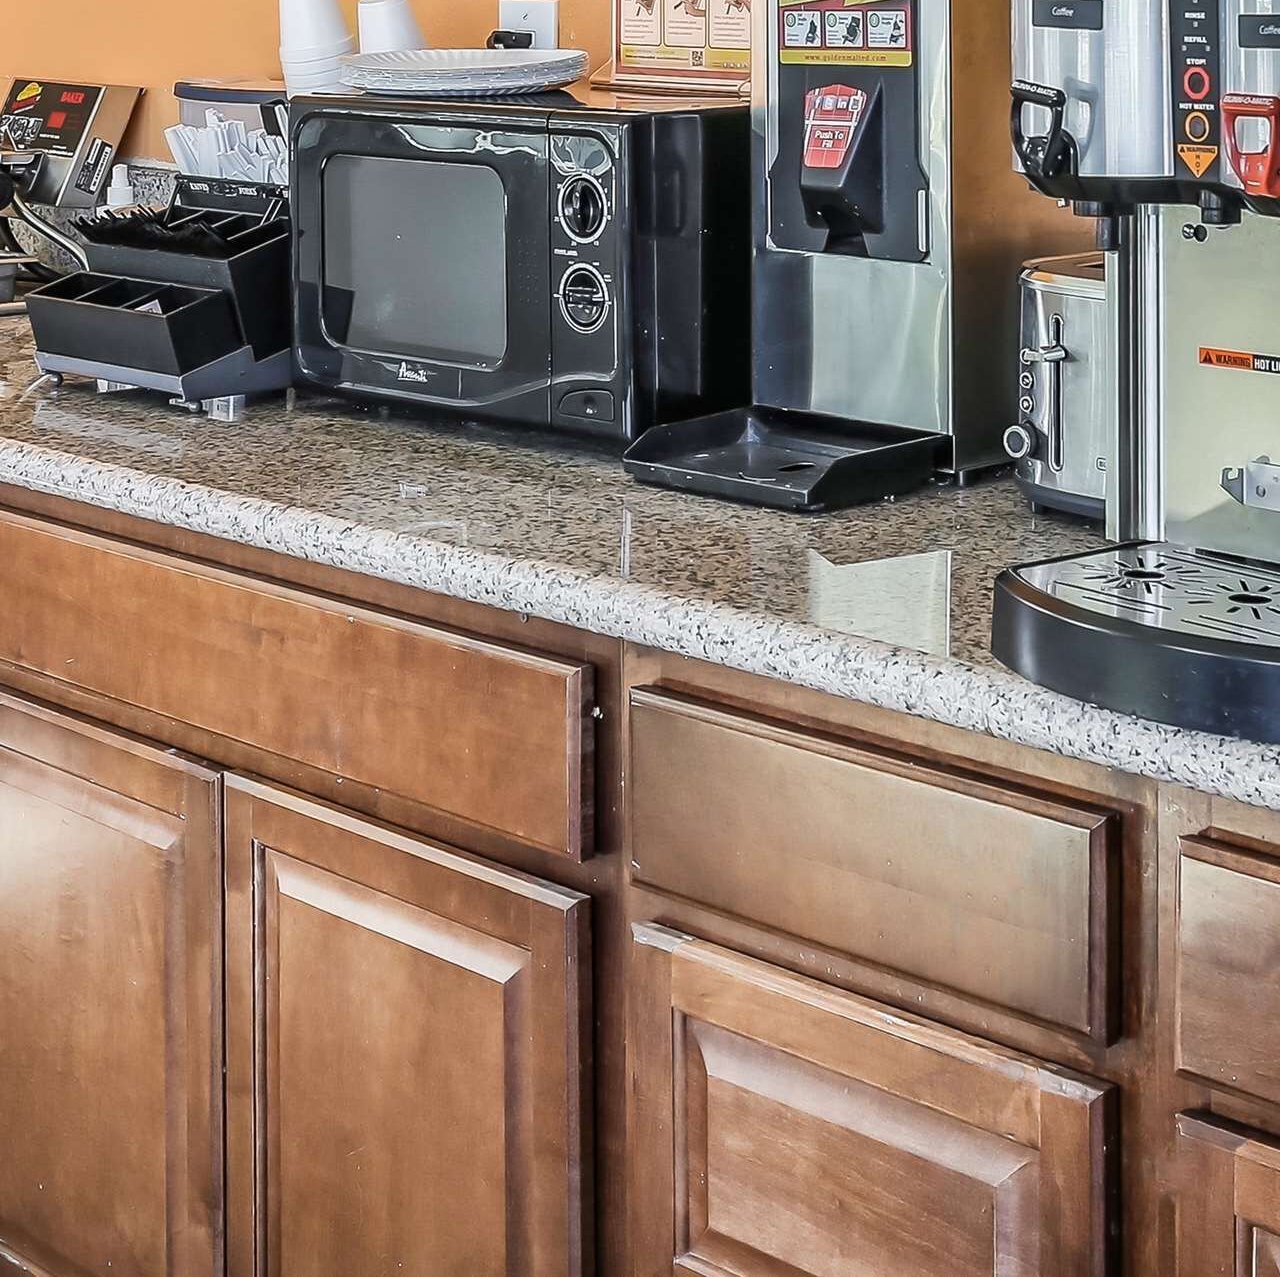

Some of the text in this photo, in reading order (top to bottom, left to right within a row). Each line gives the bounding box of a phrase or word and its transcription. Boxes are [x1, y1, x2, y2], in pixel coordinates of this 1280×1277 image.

[1051, 6, 1074, 18] Coffee
[1183, 36, 1208, 44] REFILL
[1193, 103, 1215, 111] WATER
[815, 130, 844, 140] Push To
[1215, 354, 1251, 367] WARNING
[1254, 358, 1270, 372] HOT
